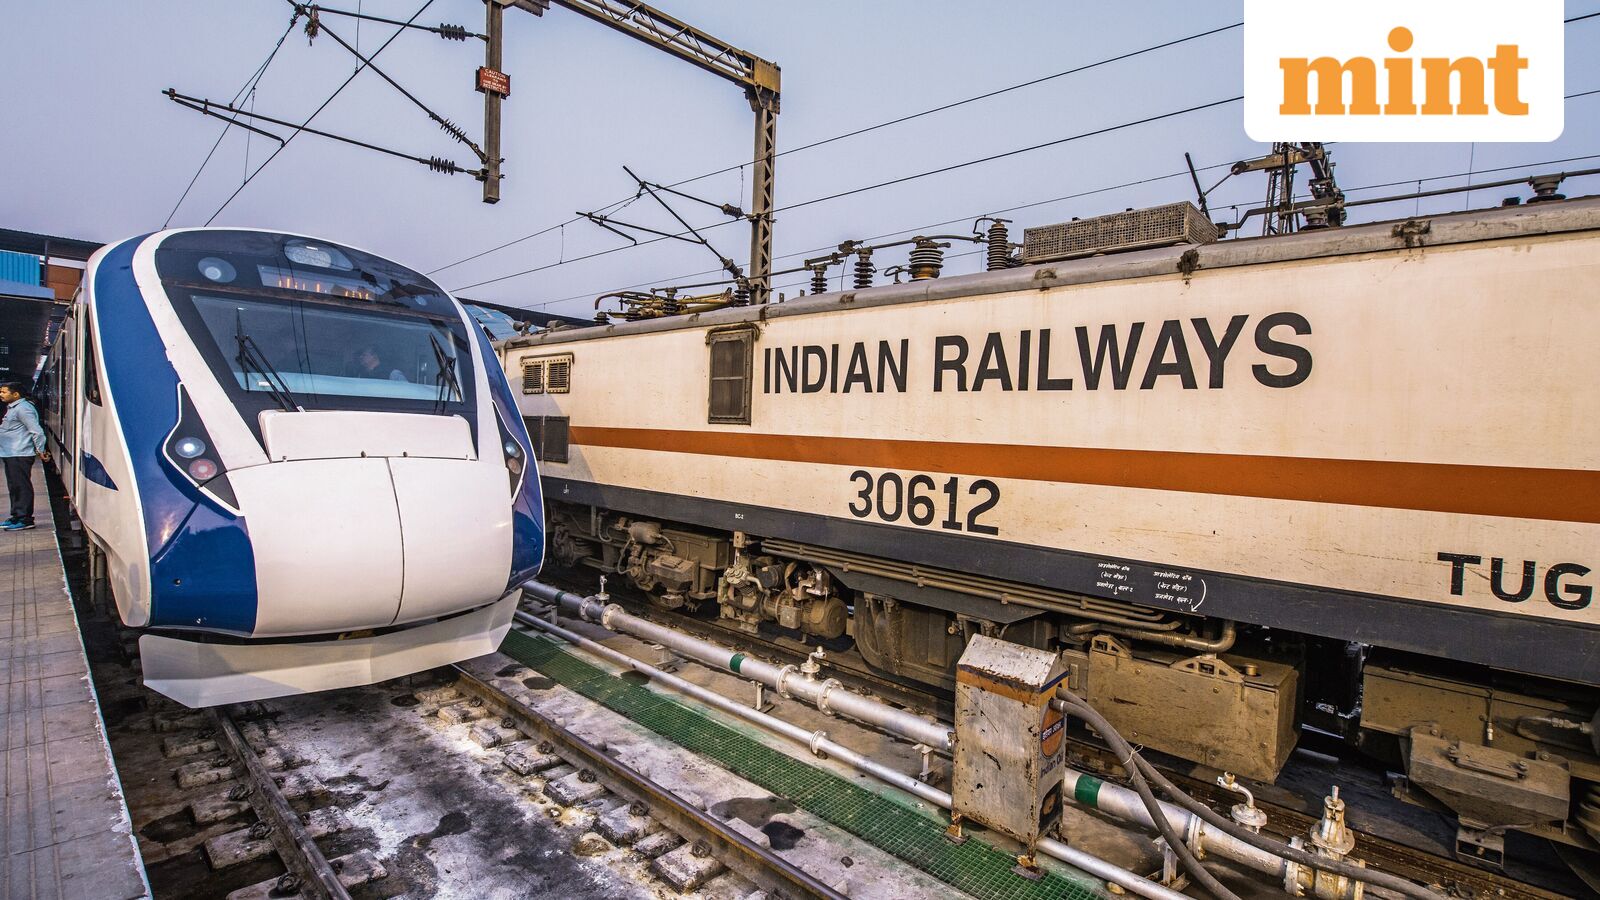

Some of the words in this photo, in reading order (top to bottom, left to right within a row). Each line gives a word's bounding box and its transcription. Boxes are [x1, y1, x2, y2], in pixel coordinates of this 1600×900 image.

[763, 339, 909, 394] INDIAN
[933, 312, 1313, 393] RAILWAYS
[849, 470, 1001, 536] 30612
[1437, 552, 1593, 610] TUG
